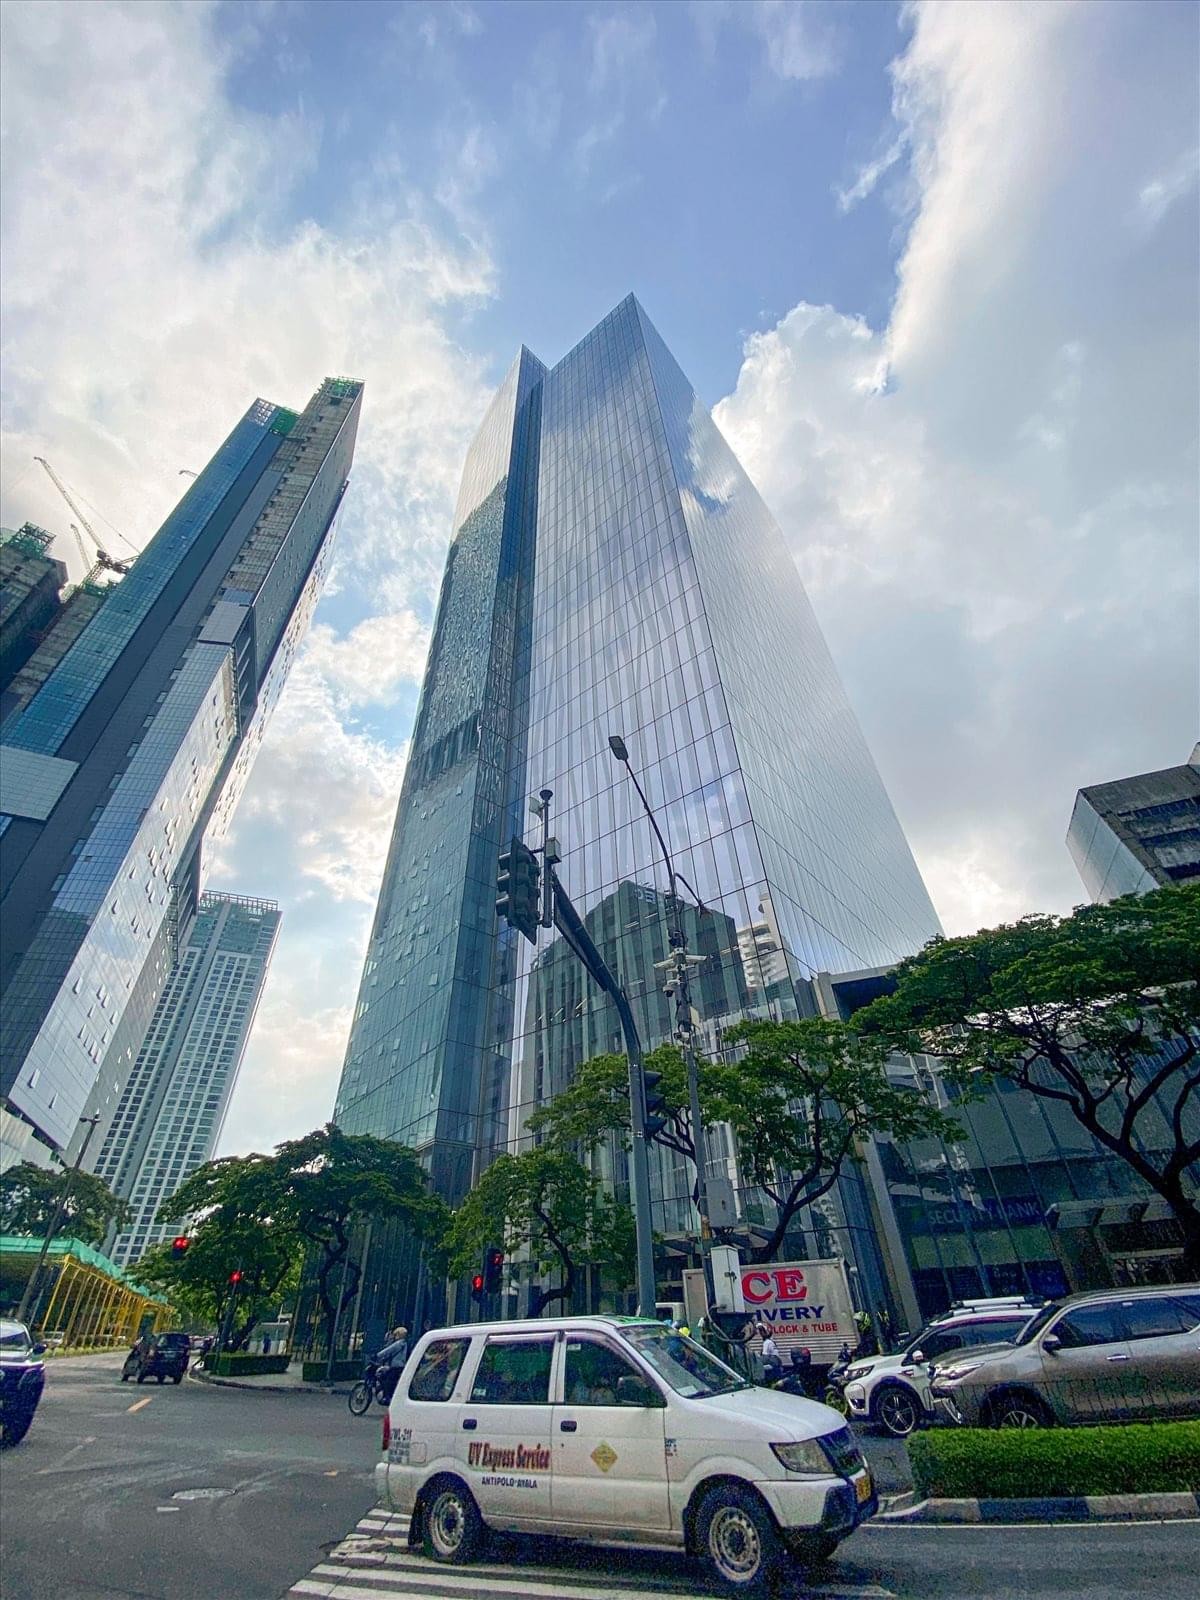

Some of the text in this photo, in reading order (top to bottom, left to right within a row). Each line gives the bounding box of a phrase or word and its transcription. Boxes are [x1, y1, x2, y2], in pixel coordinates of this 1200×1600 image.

[741, 1269, 808, 1305] CE
[756, 1305, 825, 1322] IVERY
[802, 1324, 809, 1333] &
[811, 1322, 838, 1333] TUBE
[468, 1442, 551, 1473] UV Express Service
